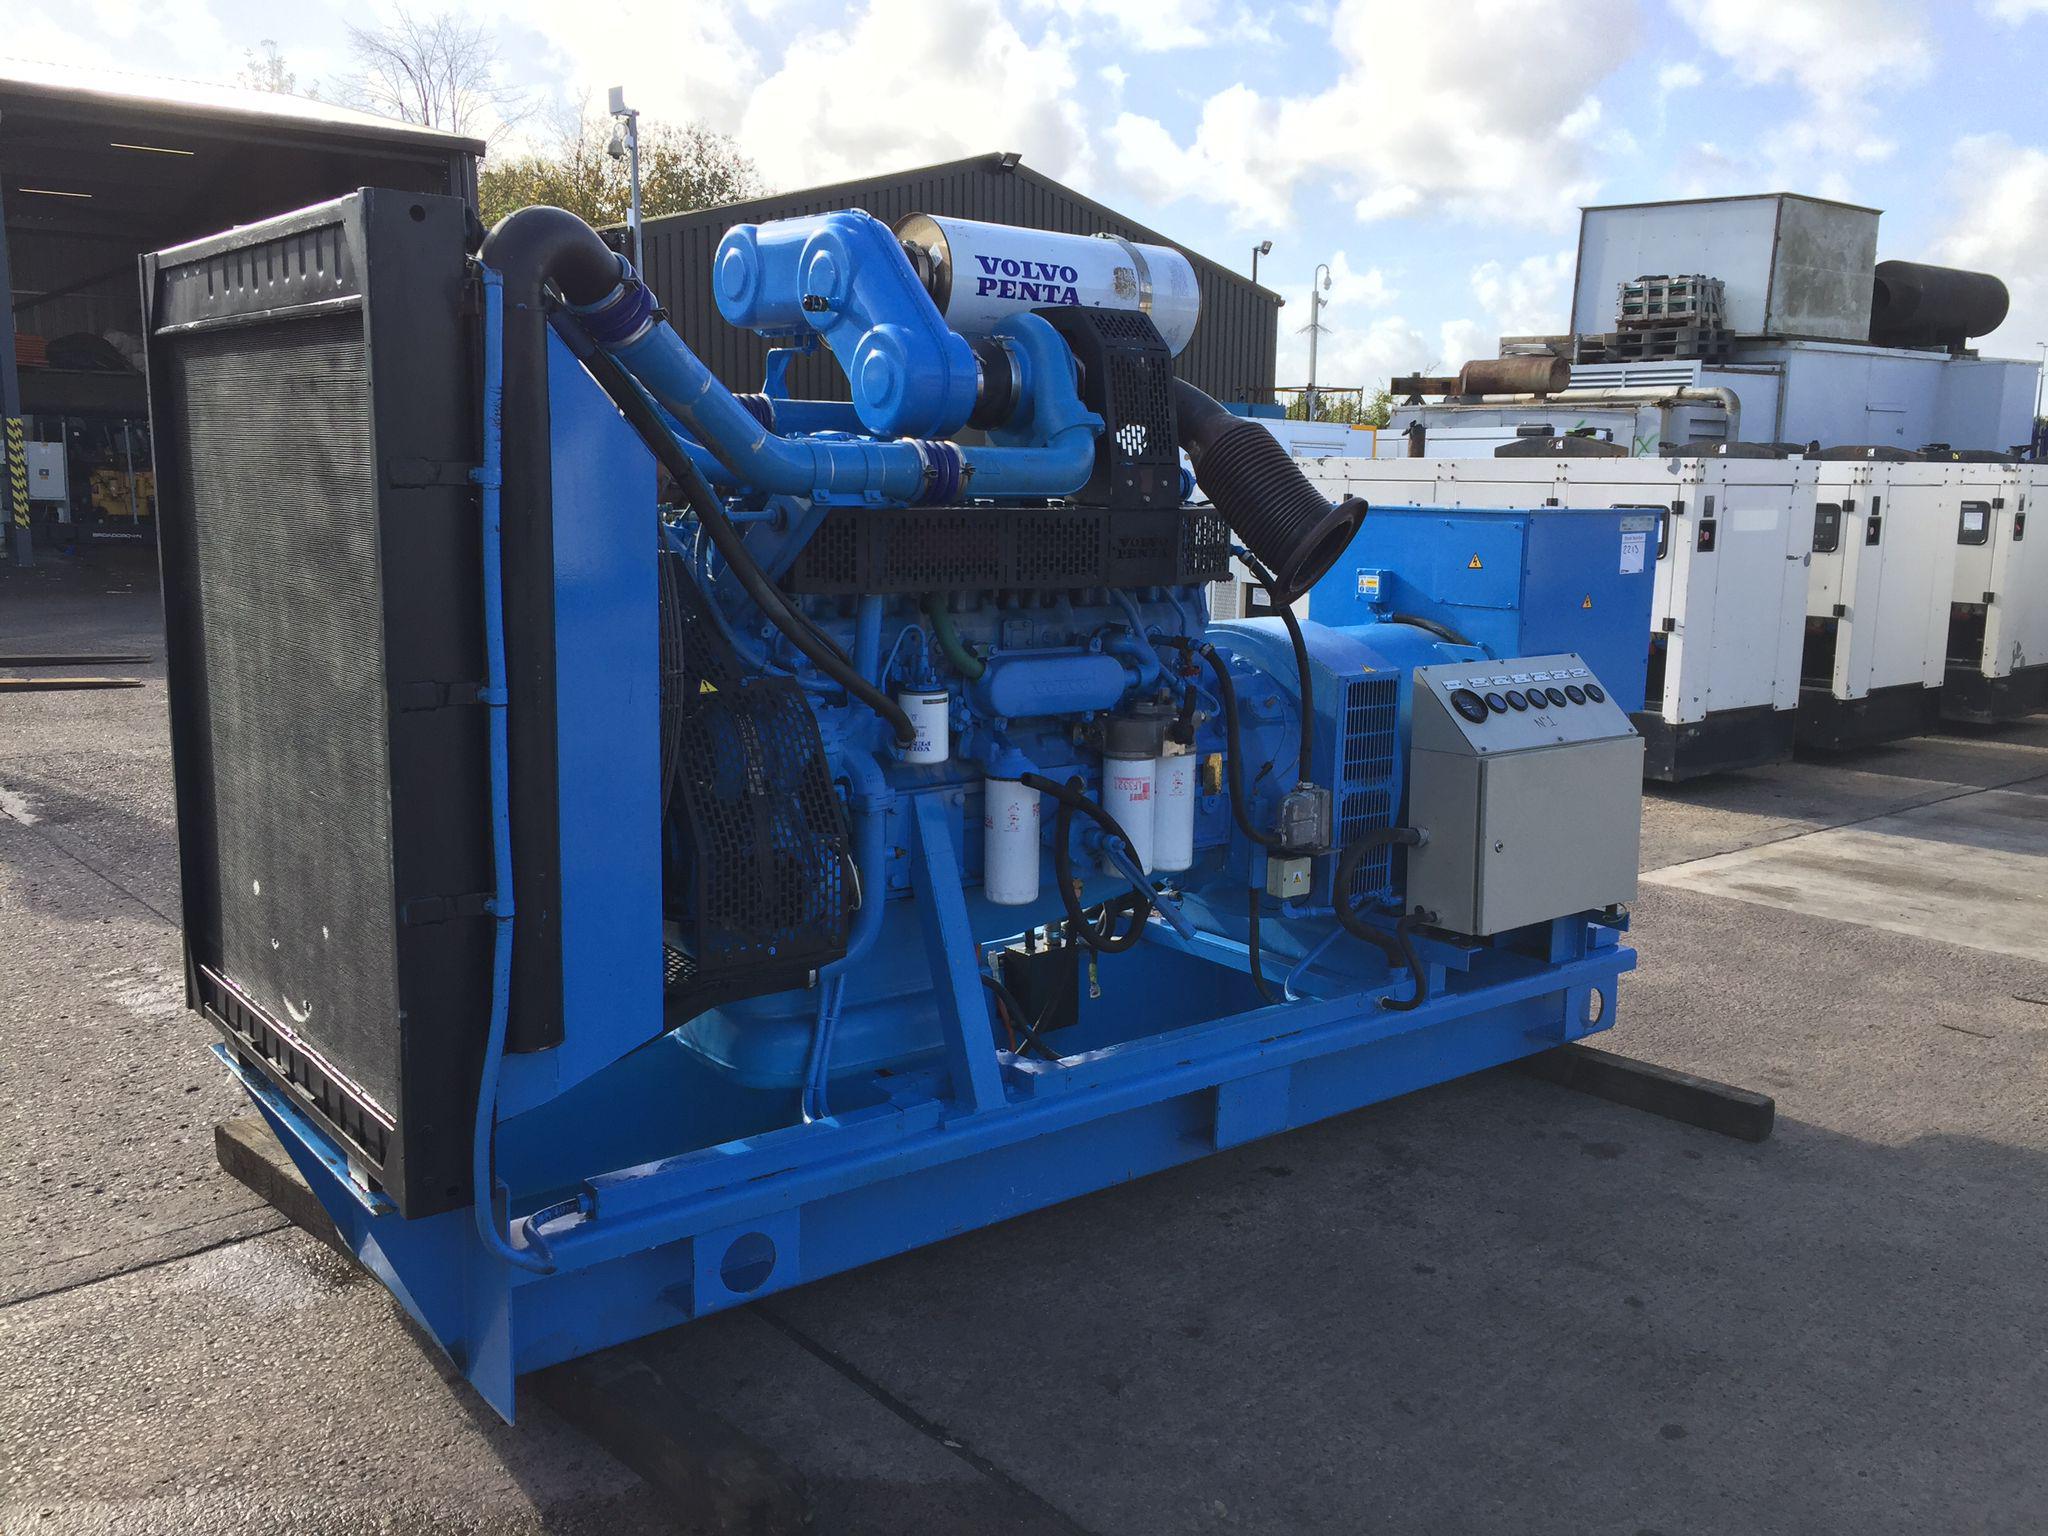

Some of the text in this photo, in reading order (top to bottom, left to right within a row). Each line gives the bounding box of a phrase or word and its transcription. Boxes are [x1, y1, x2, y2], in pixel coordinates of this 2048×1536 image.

[975, 255, 1078, 283] VOLVO
[976, 277, 1082, 306] PENTA
[1118, 537, 1168, 548] VOLVO
